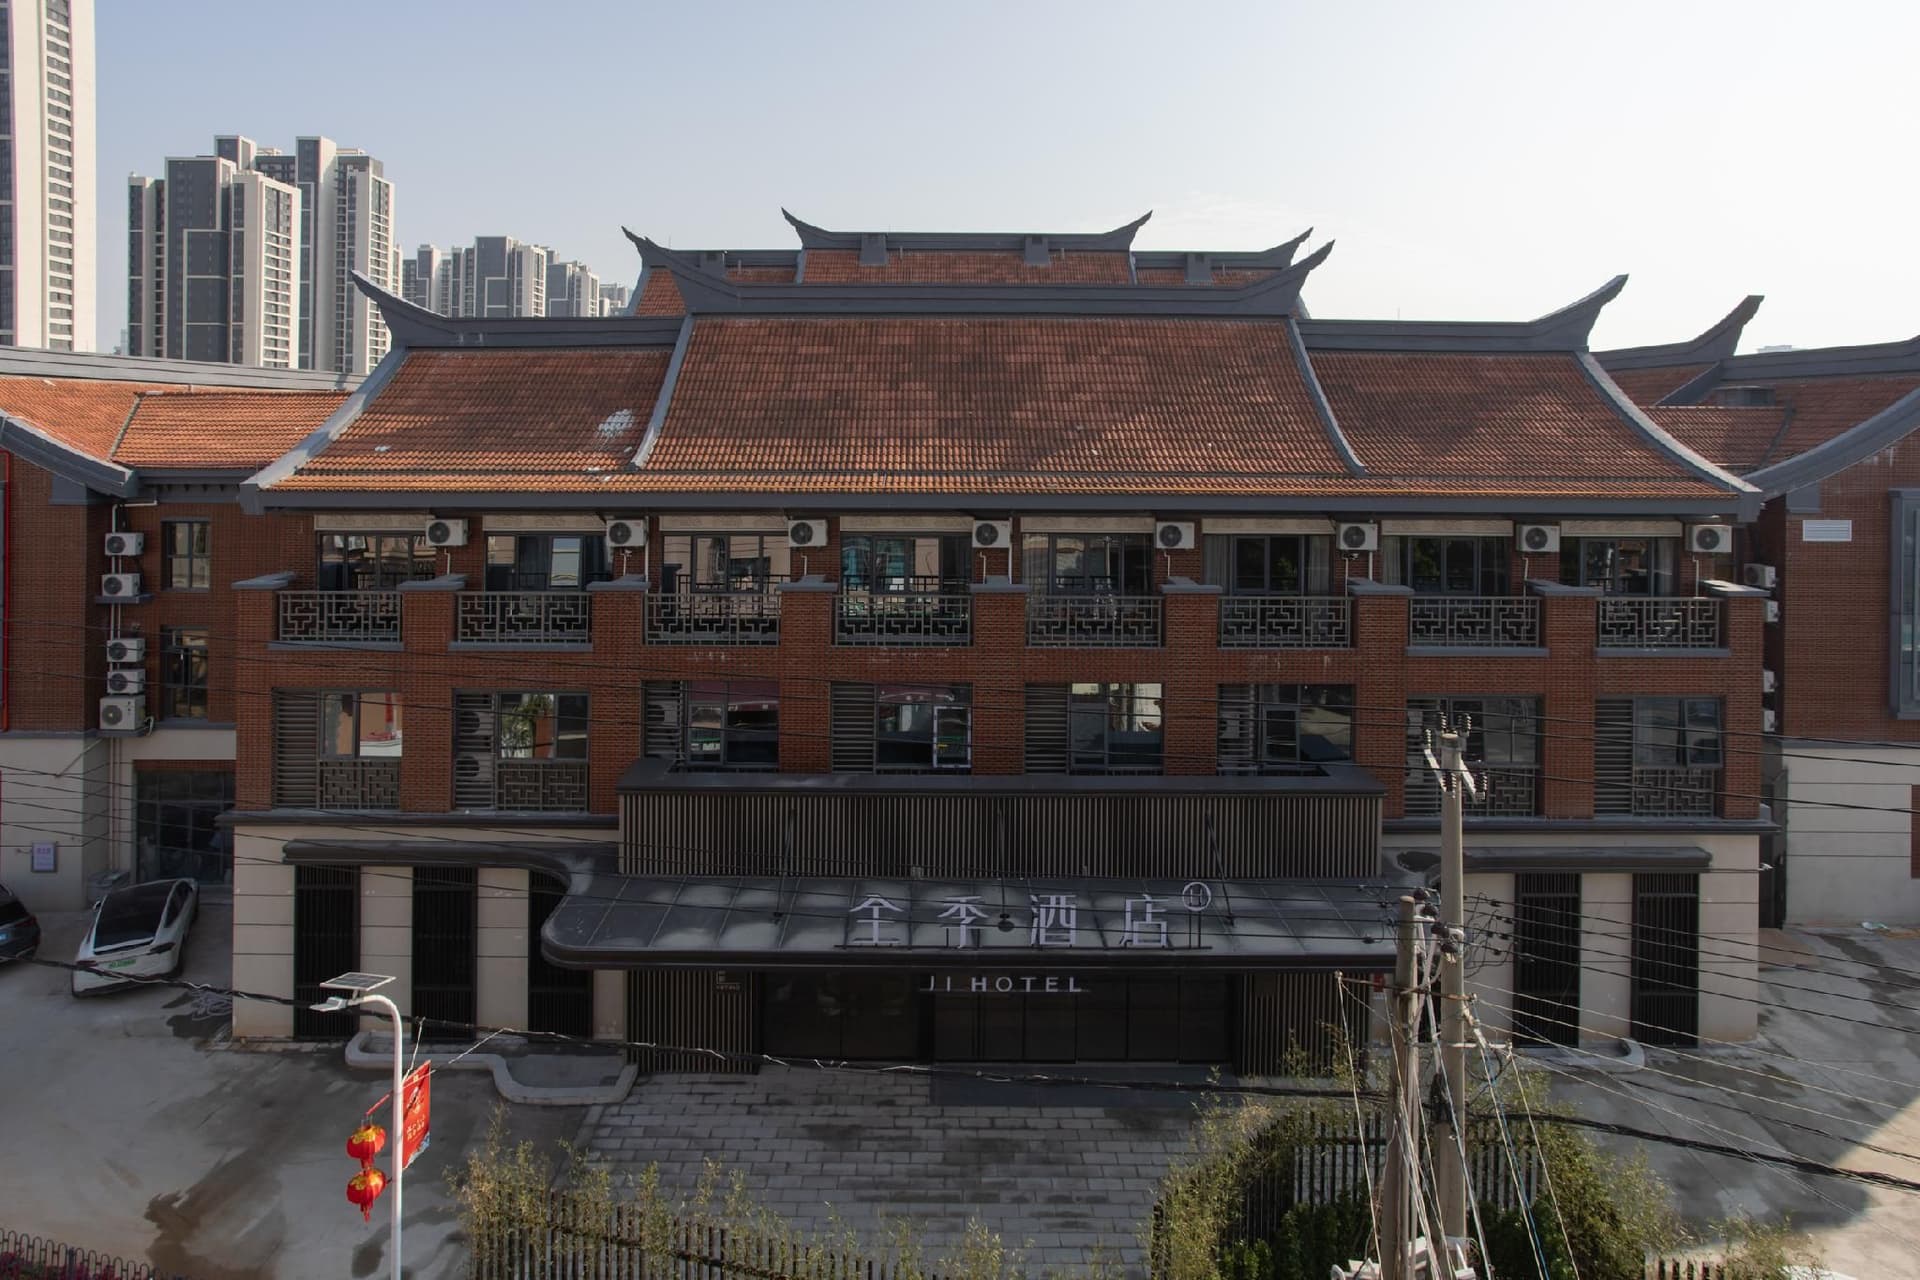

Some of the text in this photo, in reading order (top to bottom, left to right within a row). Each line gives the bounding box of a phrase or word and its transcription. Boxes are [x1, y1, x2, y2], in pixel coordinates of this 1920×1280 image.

[849, 893, 1170, 948] 全季酒店
[928, 975, 1082, 993] JI HOTEL
